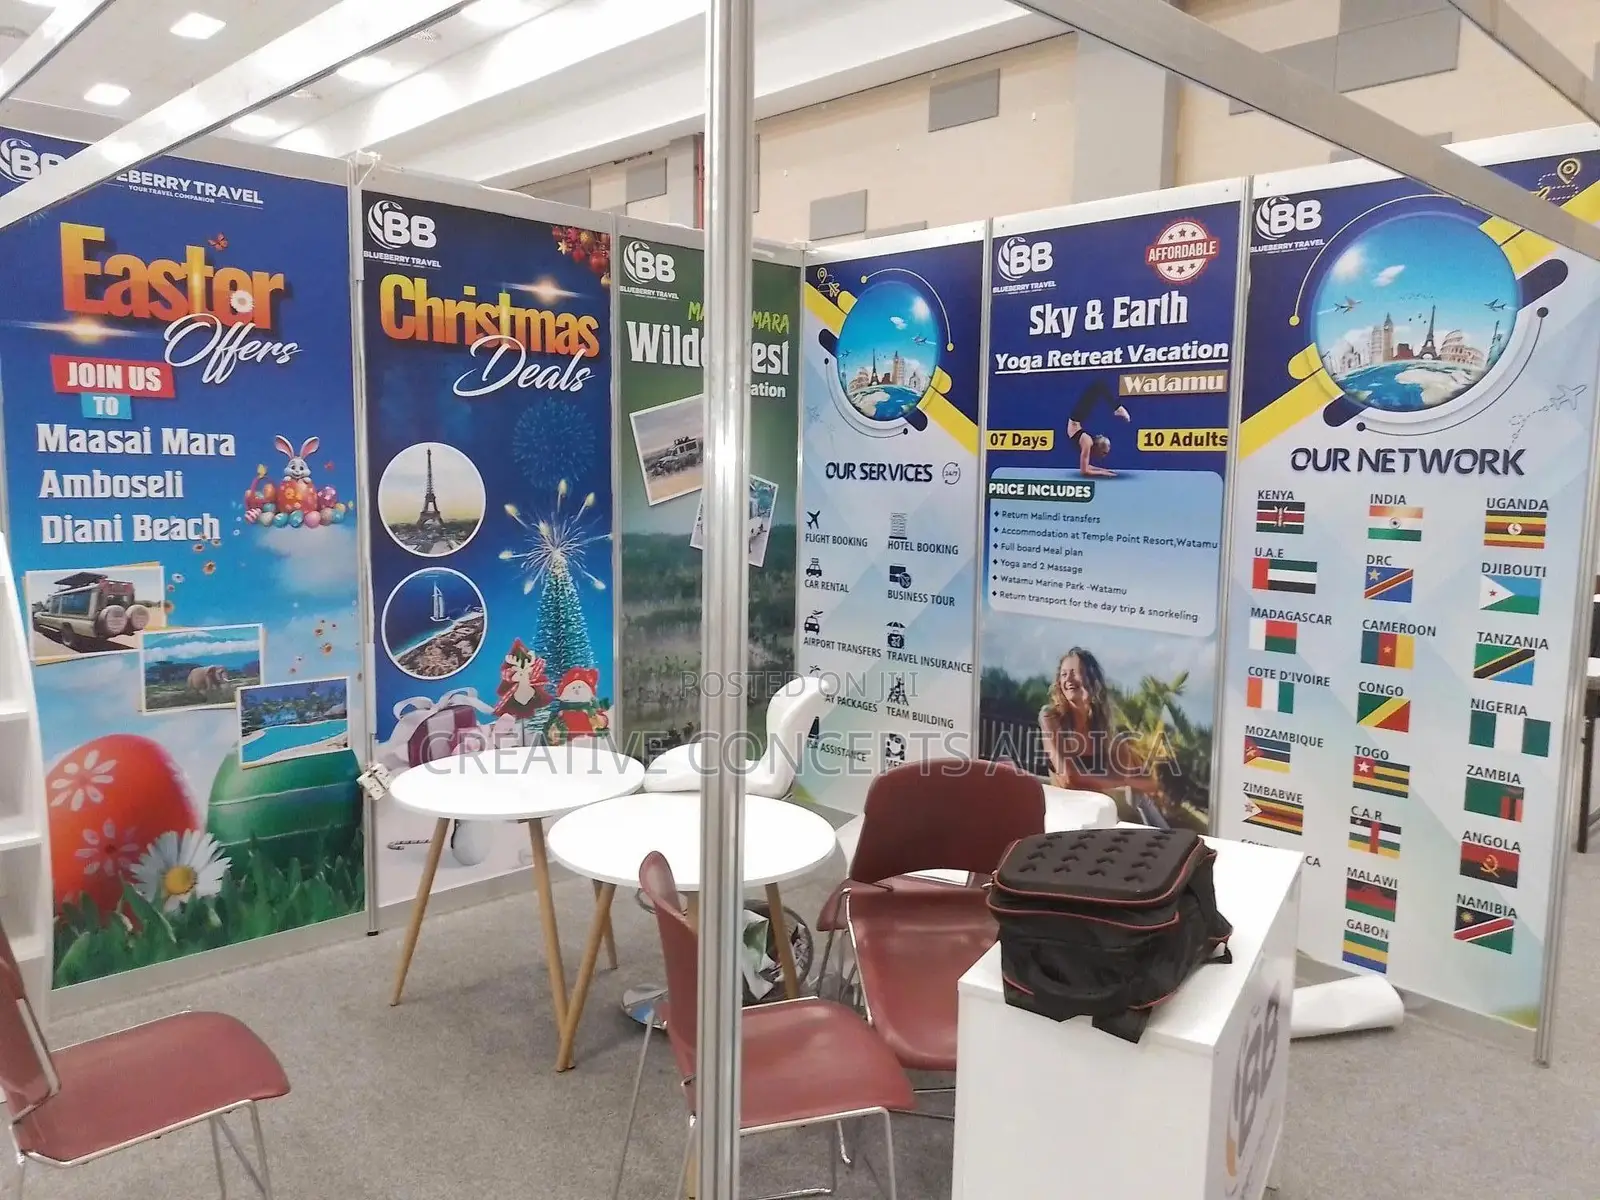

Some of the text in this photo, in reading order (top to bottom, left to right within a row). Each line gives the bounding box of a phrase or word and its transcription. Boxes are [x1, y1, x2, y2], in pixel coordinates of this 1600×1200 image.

[116, 169, 264, 204] EBERRY TRAVEL
[128, 184, 215, 204] YOUR TRAVEL COMPANION
[1270, 199, 1322, 235] BB
[383, 210, 437, 249] BB
[1148, 240, 1217, 263] AFFORDABLE
[1250, 241, 1294, 253] BLUEBERRY
[1294, 239, 1325, 248] TRAVEL
[363, 250, 410, 263] BLUEBERRY
[411, 257, 442, 268] TRAVEL
[635, 250, 676, 283] BB
[1009, 241, 1054, 275] BB
[60, 221, 285, 330] Easter
[1030, 280, 1057, 289] TRAVEL
[656, 289, 680, 300] TRAVEL
[380, 273, 600, 359] Christmas
[752, 310, 790, 335] MARA
[1029, 290, 1188, 339] Sky & Earth
[164, 313, 303, 385] Offers
[995, 341, 1228, 373] Yoga Retreat Vacation
[453, 334, 595, 397] Deals
[67, 361, 162, 392] JOIN US
[1123, 374, 1224, 394] Watamu
[92, 395, 119, 417] TO
[36, 423, 236, 456] Maasai Mara
[990, 433, 1048, 450] 07 Days
[1143, 431, 1228, 447] 10 Adults
[1290, 447, 1527, 476] OUR NETWORK
[825, 461, 933, 483] OUR SERVICES
[38, 469, 185, 499] Amboseli
[988, 481, 1091, 499] PRICE INCLUDES
[1257, 490, 1295, 501] KENYA
[1370, 493, 1407, 506] INDIA
[1486, 497, 1549, 511] UGANDA
[1001, 509, 1101, 524] Return Malindi transfers
[41, 512, 222, 544] Diani Beach
[1001, 527, 1069, 540] Accommodation
[1070, 531, 1080, 540] at
[1082, 531, 1114, 544] Temple
[1116, 533, 1141, 545] Point
[805, 533, 868, 547] FLIGHT BOOKING
[887, 540, 959, 555] HOTEL BOOKING
[1001, 542, 1084, 558] Full board Meal plan
[1254, 547, 1285, 559] U.A.E
[1366, 554, 1393, 567] DRC
[1001, 558, 1083, 575] Yoga and 2 Massage
[1481, 562, 1547, 578] DJIBOUTI
[804, 578, 850, 593] CAR RENTAL
[1001, 574, 1034, 586] Watamu
[1035, 578, 1063, 589] Marine
[1065, 580, 1085, 591] Park
[887, 589, 956, 607] BUSINESS TOUR
[999, 590, 1199, 624] Return transport for the day trip & snorkeling
[1250, 607, 1333, 626] MADAGASCAR
[1362, 618, 1437, 637] CAMEROON
[803, 636, 882, 659] AIRPORT TRANSFERS
[1477, 631, 1549, 650] TANZANIA
[886, 650, 973, 674] TRAVEL INSURANCE
[1247, 666, 1331, 688] COTE D'IVOIRE
[1358, 681, 1405, 697] CONGO
[837, 696, 878, 713] PACKAGES
[1470, 698, 1528, 717] NIGERIA
[886, 705, 954, 729] TEAM BUILDING
[1245, 725, 1324, 748] MOZAMBIQUE
[821, 742, 867, 762] ASSISTANCE
[1354, 745, 1390, 761] TOGO
[1466, 764, 1521, 785] ZAMBIA
[1242, 782, 1303, 804] ZIMBABWE
[1351, 805, 1383, 822] C.A.R
[1462, 830, 1522, 853] ANGOLA
[1347, 866, 1398, 890] MALAWI
[1456, 893, 1518, 919] NAMIBIA
[1346, 918, 1389, 940] GABON
